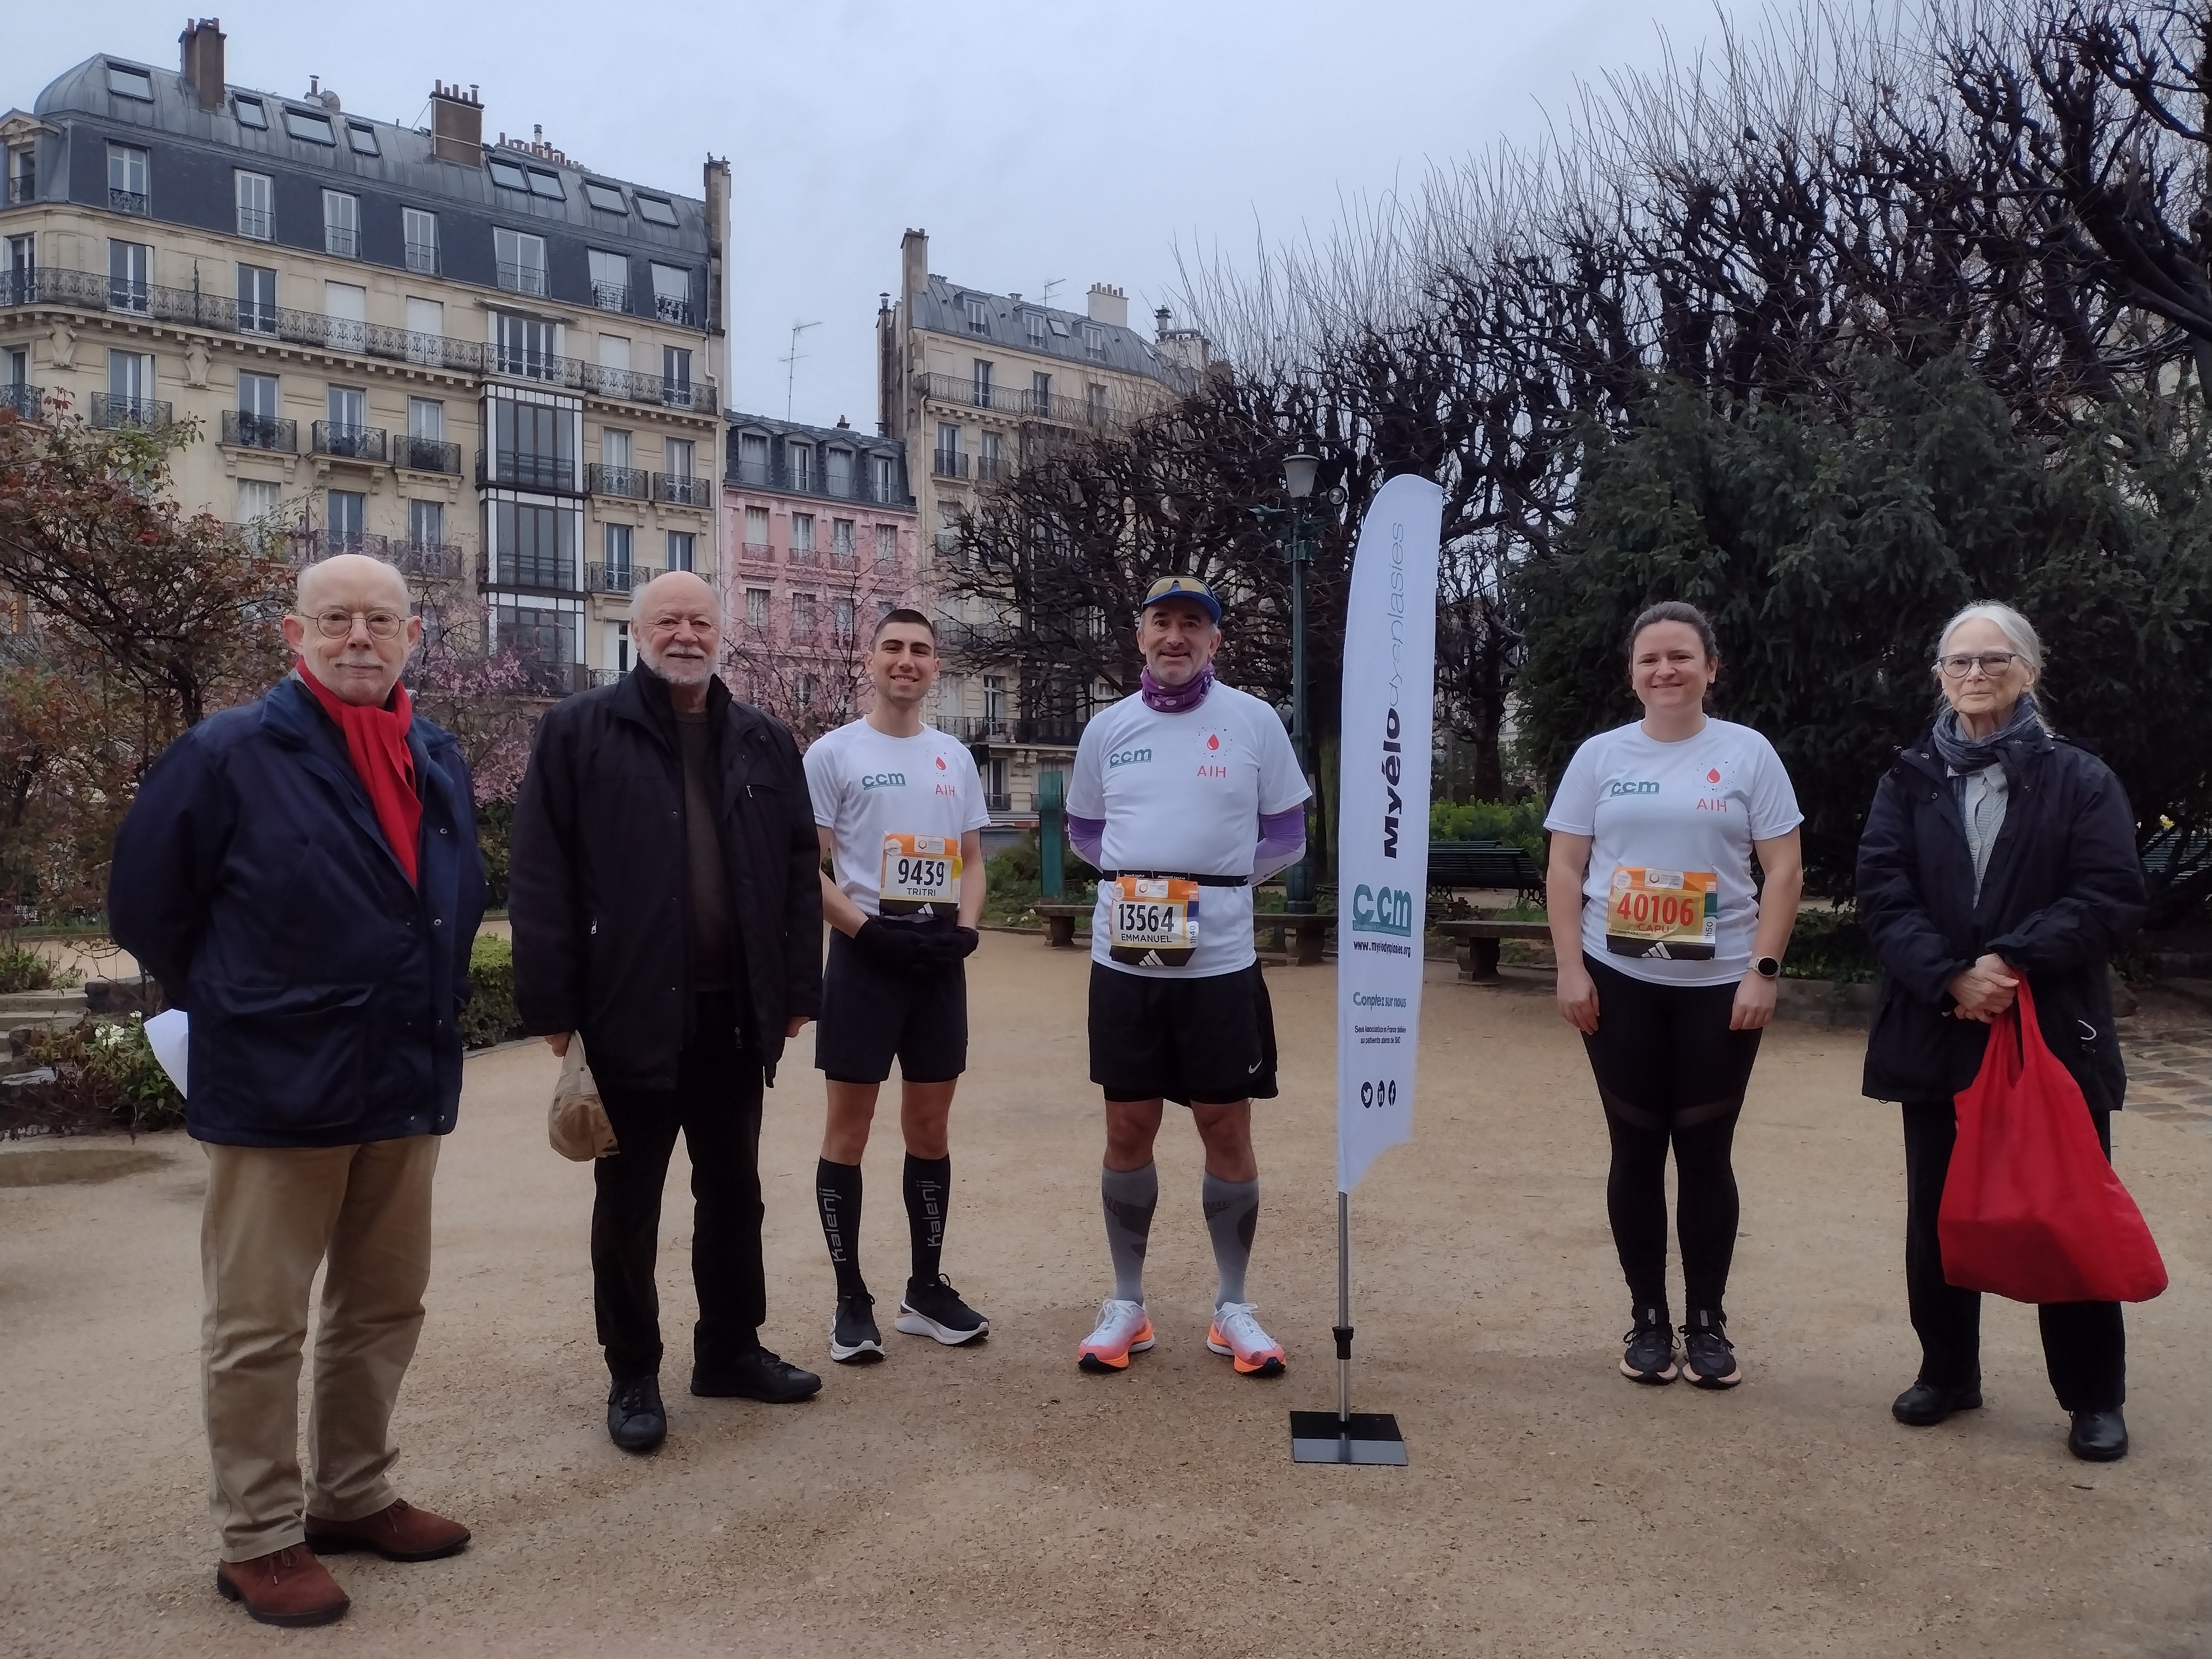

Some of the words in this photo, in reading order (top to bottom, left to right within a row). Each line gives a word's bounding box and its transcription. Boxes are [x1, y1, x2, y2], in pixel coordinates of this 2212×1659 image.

[1110, 748, 1152, 767] ccm
[1197, 765, 1227, 778] AIH
[862, 773, 906, 789] ccm
[1610, 781, 1660, 794] ccm
[935, 784, 956, 797] AIH
[1697, 798, 1727, 812] AIH
[898, 858, 945, 886] 9439
[907, 888, 936, 896] TRITRI
[1616, 891, 1694, 926] 40106
[1119, 903, 1174, 932] 13564
[1637, 923, 1670, 933] CAPU
[1121, 933, 1172, 943] EMMANUEL
[1353, 992, 1384, 1010] Comptez
[1394, 998, 1406, 1008] nous
